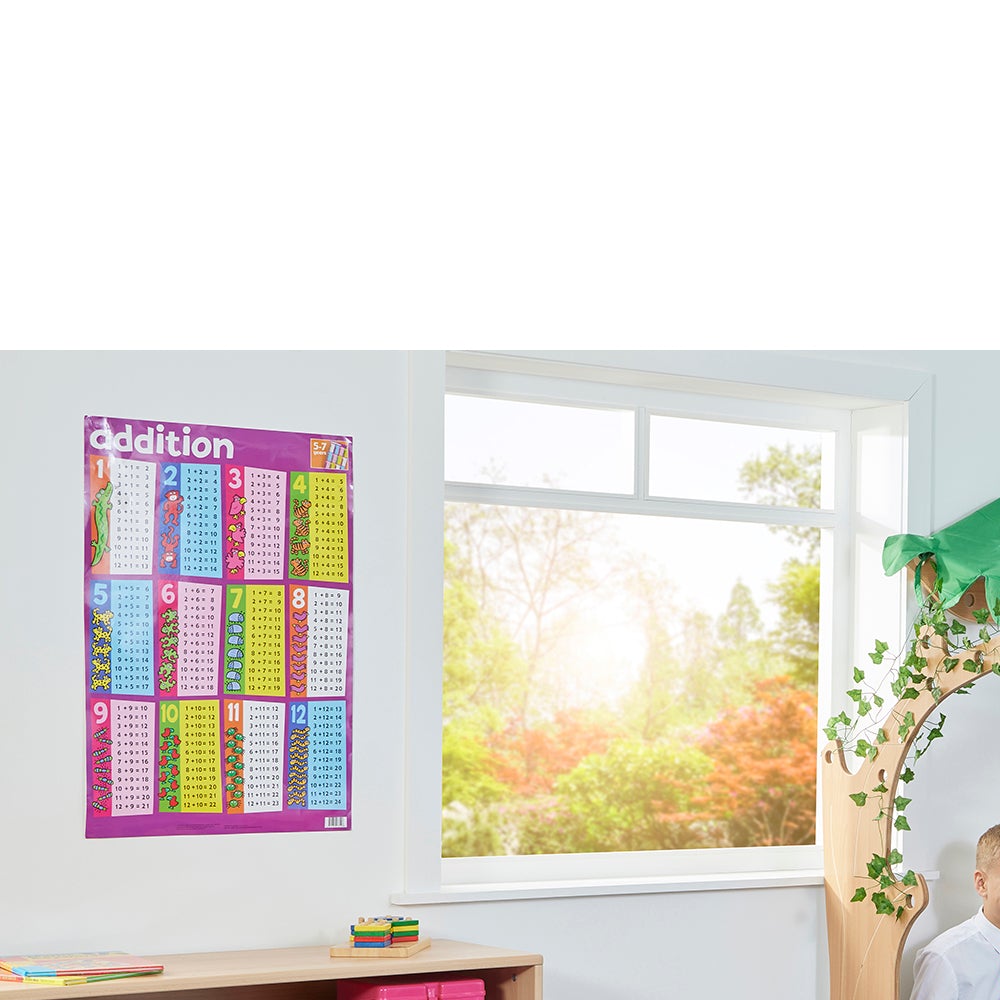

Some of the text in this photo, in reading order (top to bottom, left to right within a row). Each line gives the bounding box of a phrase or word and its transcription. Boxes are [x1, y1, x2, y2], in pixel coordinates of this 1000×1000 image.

[90, 424, 234, 458] addition
[313, 442, 326, 450] 5-7
[97, 459, 104, 478] 1
[164, 466, 177, 486] 2
[228, 468, 242, 489] 3
[293, 475, 307, 494] 4
[93, 583, 108, 605] 5
[161, 584, 175, 604] 6
[230, 588, 243, 608] 7
[292, 588, 305, 609] 8
[93, 702, 108, 724] 9
[161, 704, 178, 723] 10
[228, 702, 240, 722] 11
[290, 704, 306, 724] 12
